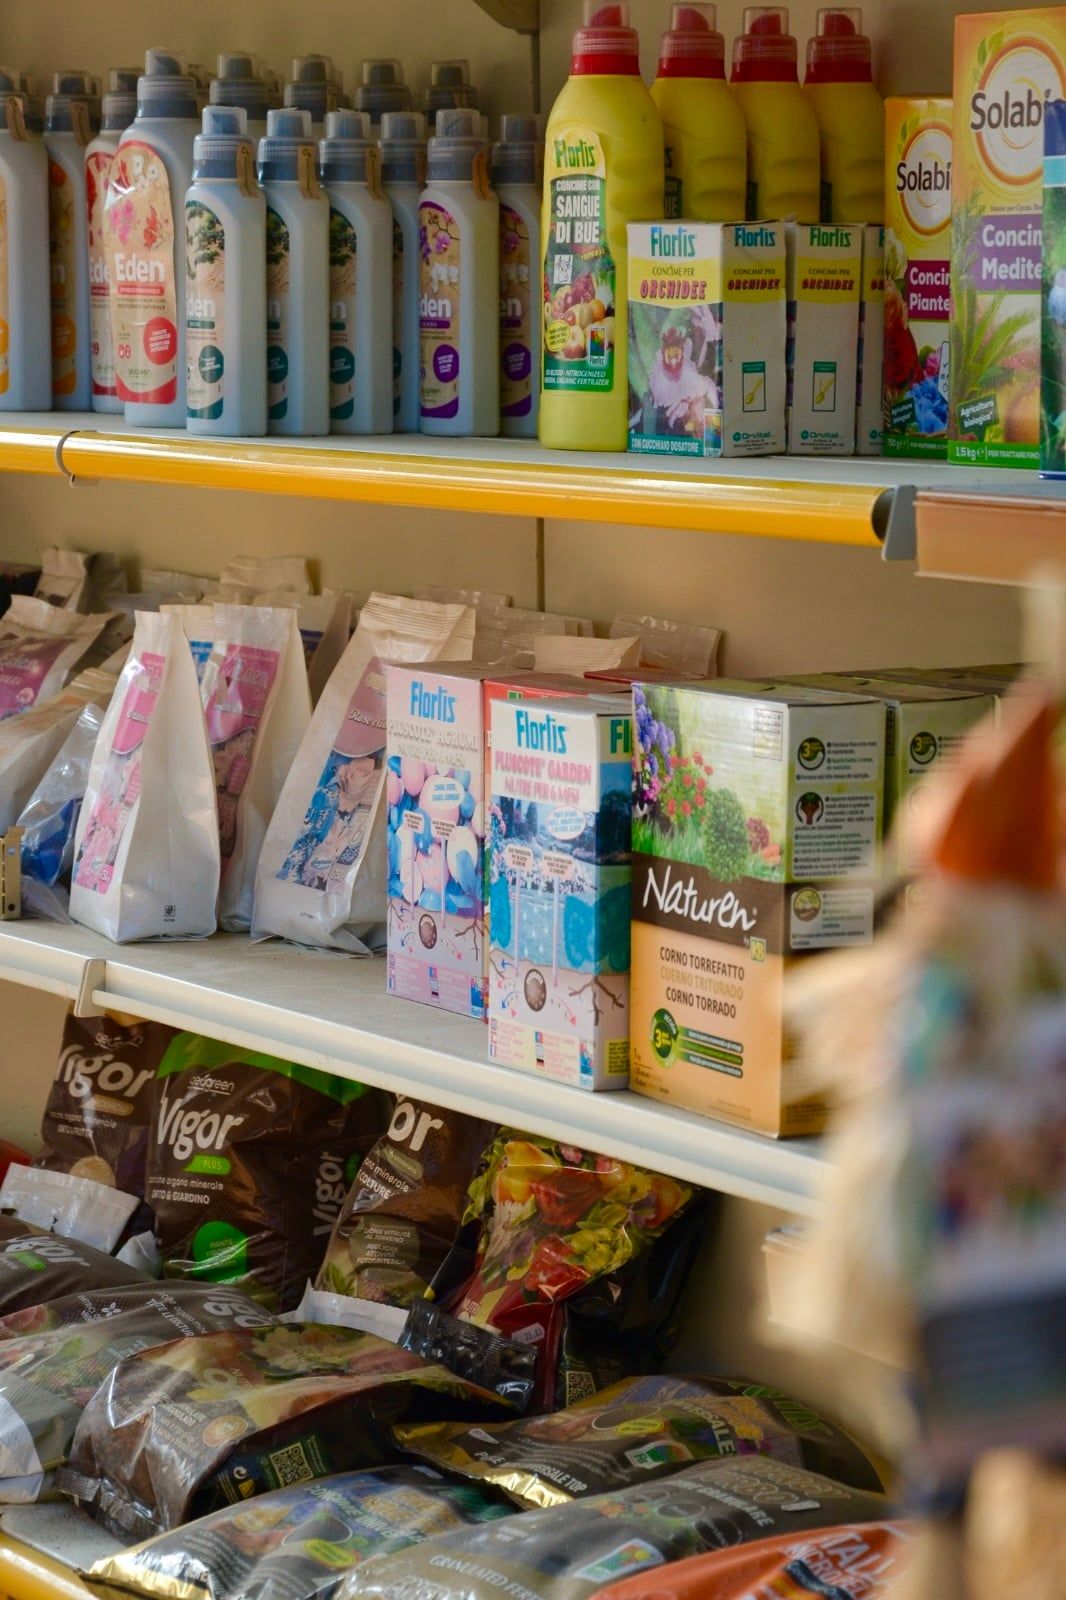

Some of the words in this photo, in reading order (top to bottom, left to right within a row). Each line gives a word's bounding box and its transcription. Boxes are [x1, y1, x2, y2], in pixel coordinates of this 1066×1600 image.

[970, 89, 1051, 131] Solab
[554, 140, 596, 168] Flortis
[555, 180, 587, 191] CONCIME
[556, 195, 600, 218] SANGUE
[556, 222, 570, 243] DI
[574, 221, 600, 243] BUE
[650, 226, 696, 257] Flortis
[734, 226, 775, 247] Flortis
[809, 226, 851, 248] Flortis
[88, 256, 111, 283] Ede
[114, 252, 165, 282] Eden
[652, 267, 683, 276] CONCIME
[684, 267, 695, 276] PER
[640, 280, 707, 299] ORCHIDEE
[727, 279, 781, 291] ORCHIDEE
[802, 279, 855, 291] ORCHIDEE
[186, 294, 216, 318] den
[499, 298, 522, 317] en
[577, 377, 610, 386] FERTILIZER
[671, 441, 699, 453] DOSATORE
[411, 680, 457, 723] Flortis
[516, 709, 567, 754] Flortis
[548, 760, 592, 785] GARDEN
[659, 946, 688, 966] CORNO
[689, 954, 745, 981] TORREFATTO
[660, 965, 693, 986] CUERNO
[694, 973, 743, 1000] TRITURADO
[665, 987, 695, 1007] CORNO
[696, 995, 736, 1019] TORRADO
[654, 1028, 662, 1048] 3
[157, 1096, 245, 1160] Vigor
[203, 1159, 222, 1170] PLUS
[189, 1179, 224, 1191] minerale
[374, 1165, 409, 1193] minerale
[166, 1190, 172, 1200] &
[172, 1190, 210, 1204] GIARDINO
[167, 1316, 194, 1337] COLTUR
[564, 1475, 588, 1495] TOP
